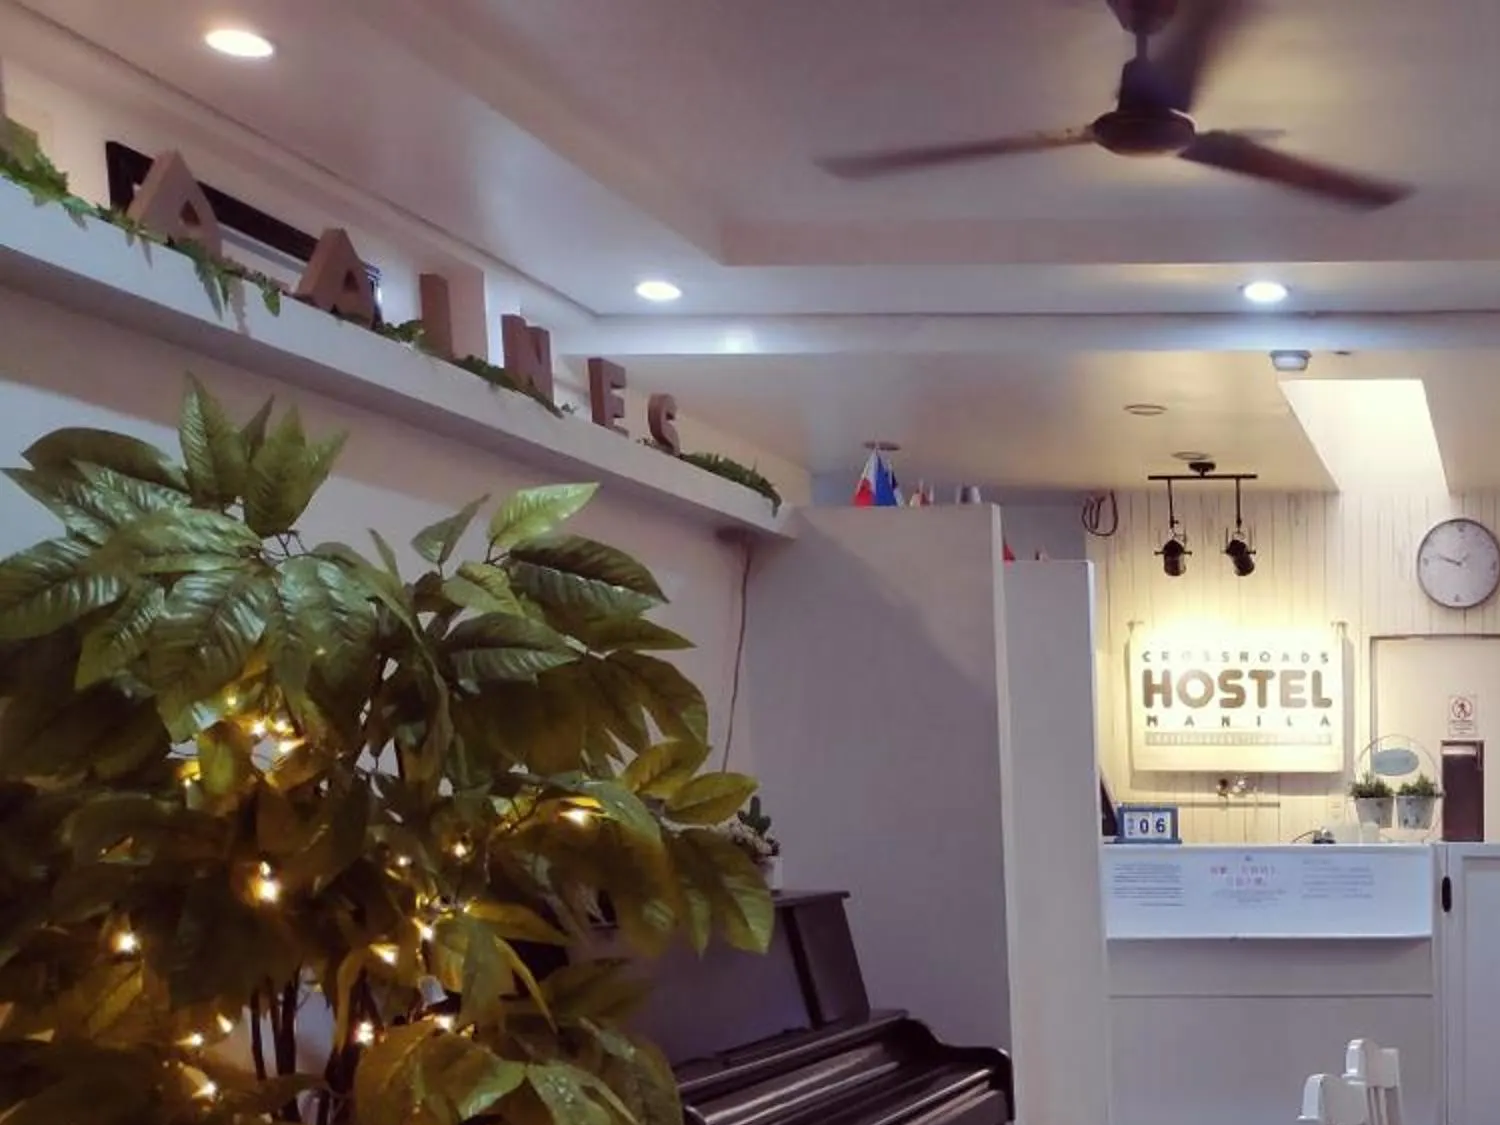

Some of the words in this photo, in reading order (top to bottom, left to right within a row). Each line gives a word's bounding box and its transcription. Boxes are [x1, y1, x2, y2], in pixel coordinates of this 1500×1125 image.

[1142, 669, 1333, 709] HOSTEL
[1146, 714, 1331, 728] MANILA
[1139, 817, 1167, 835] 06
